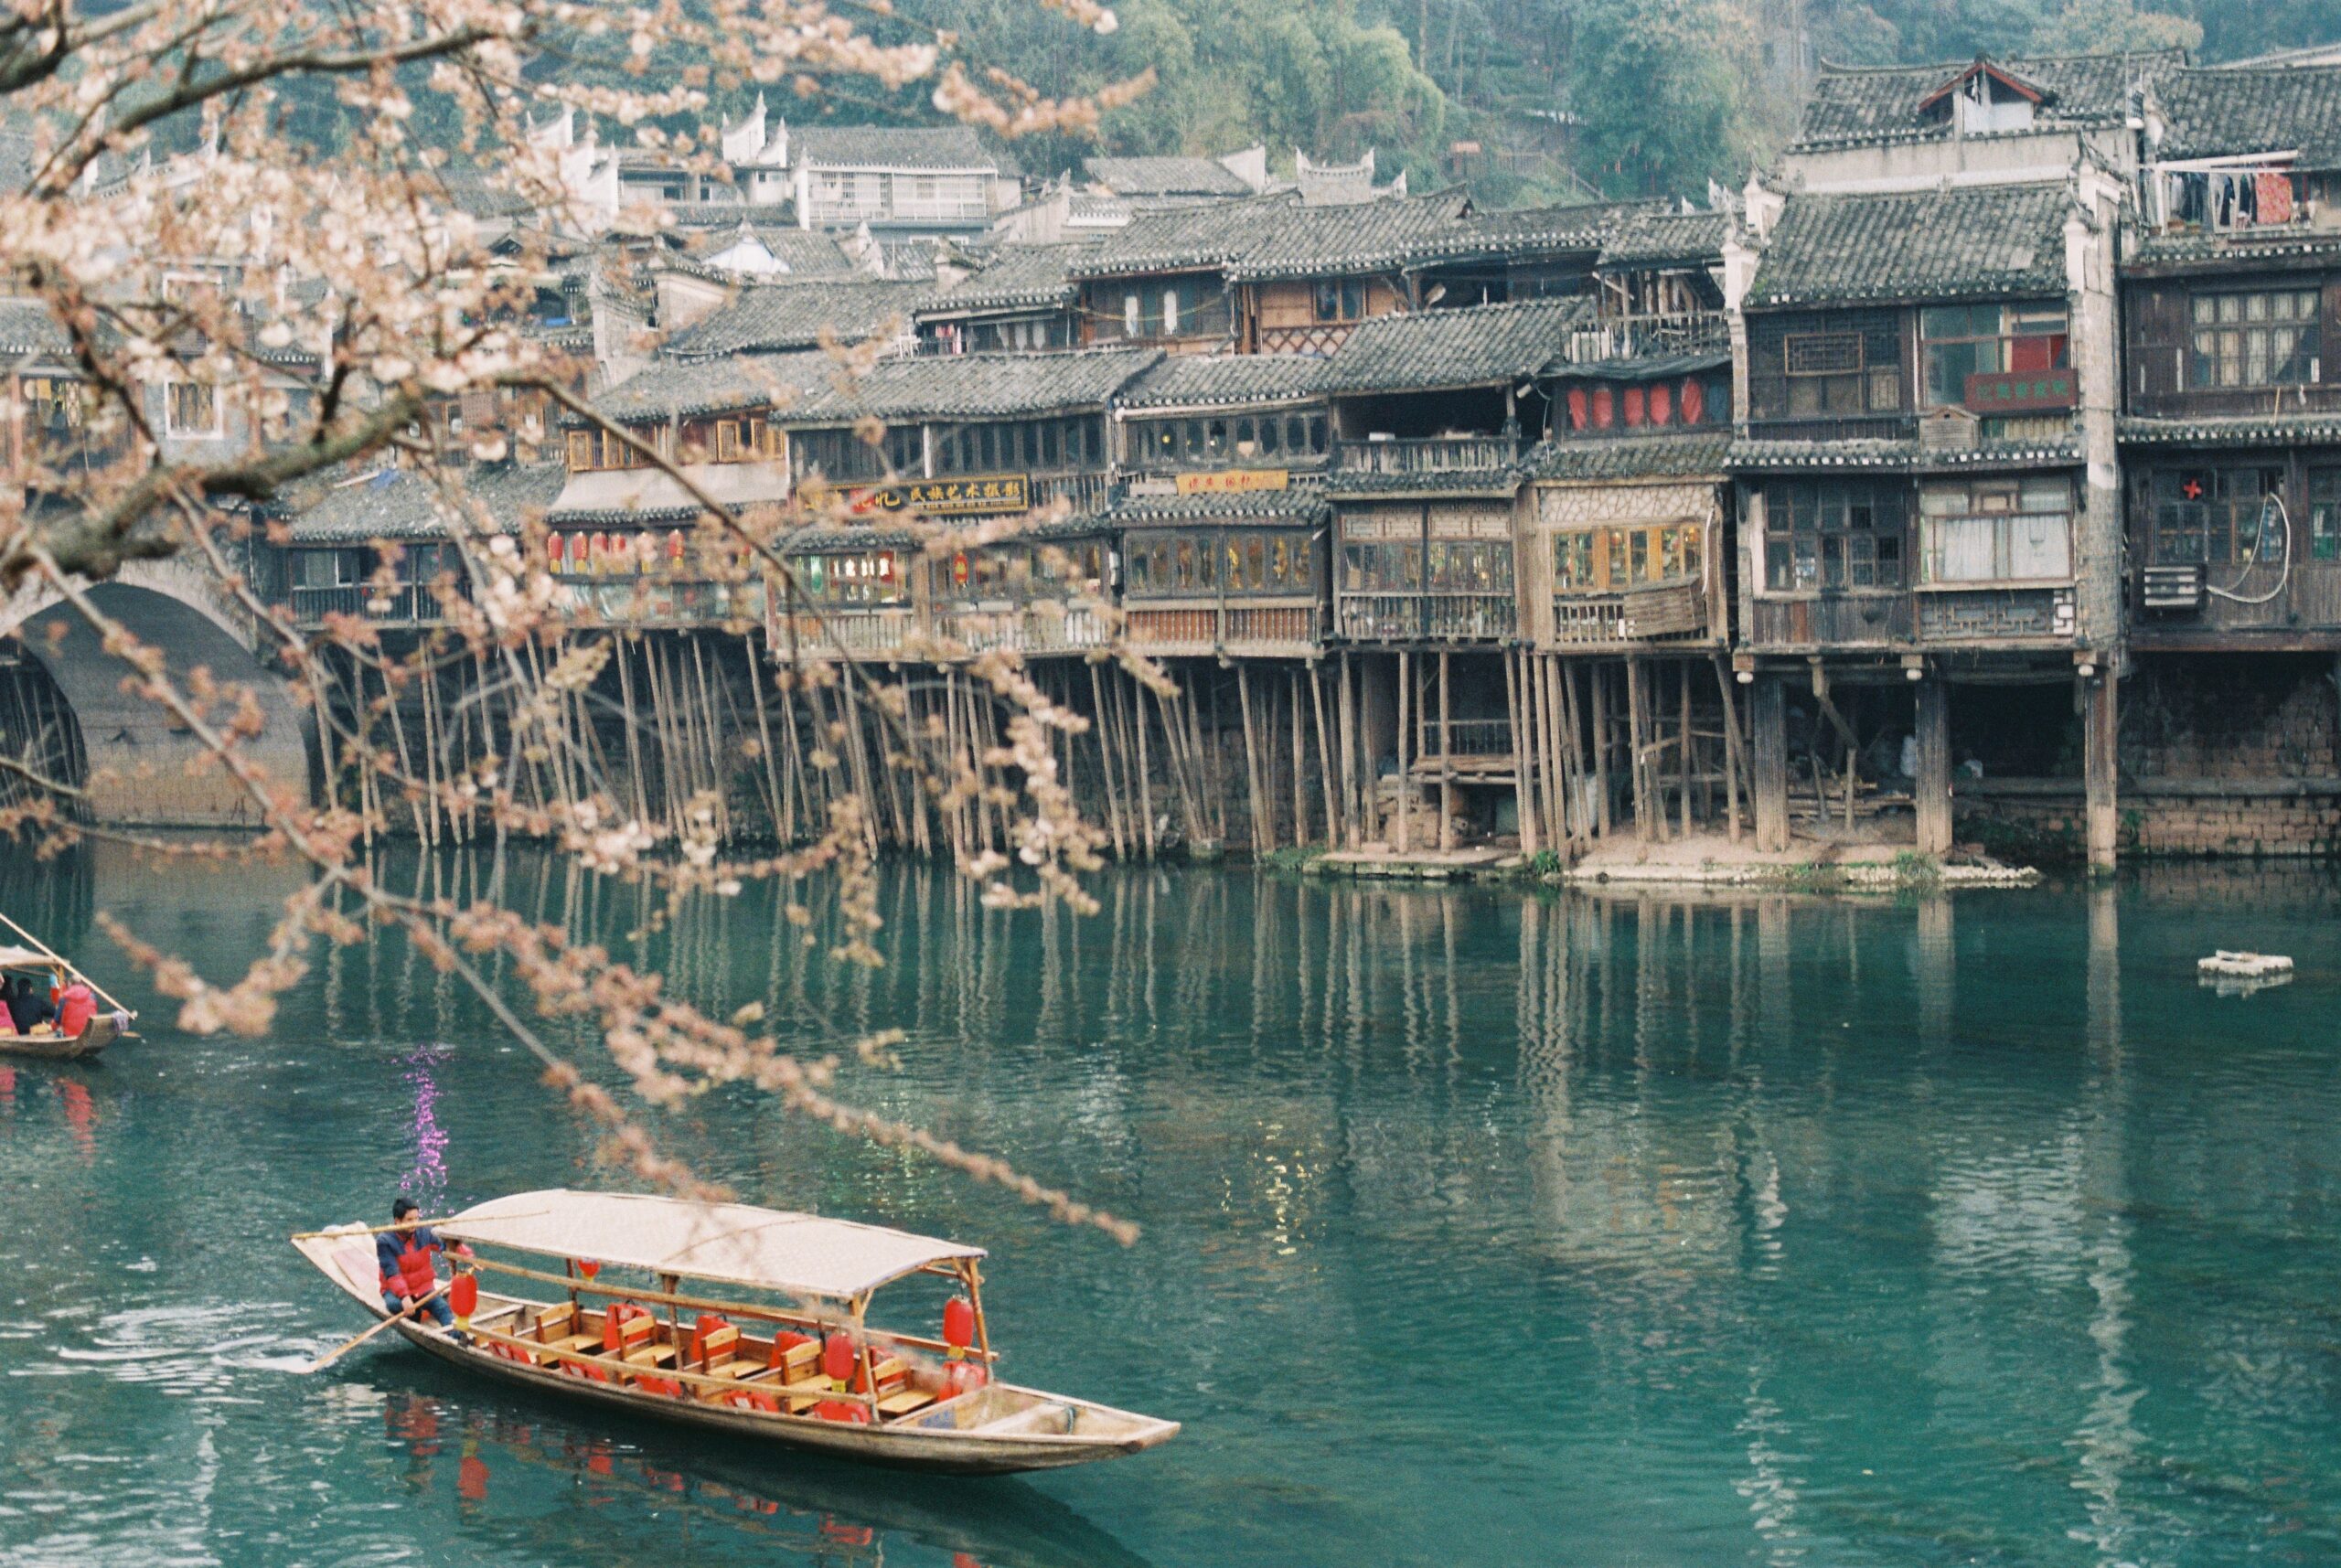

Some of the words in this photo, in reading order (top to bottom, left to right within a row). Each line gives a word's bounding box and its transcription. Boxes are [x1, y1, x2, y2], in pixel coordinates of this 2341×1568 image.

[910, 482, 1021, 503] 民族艺术摄影
